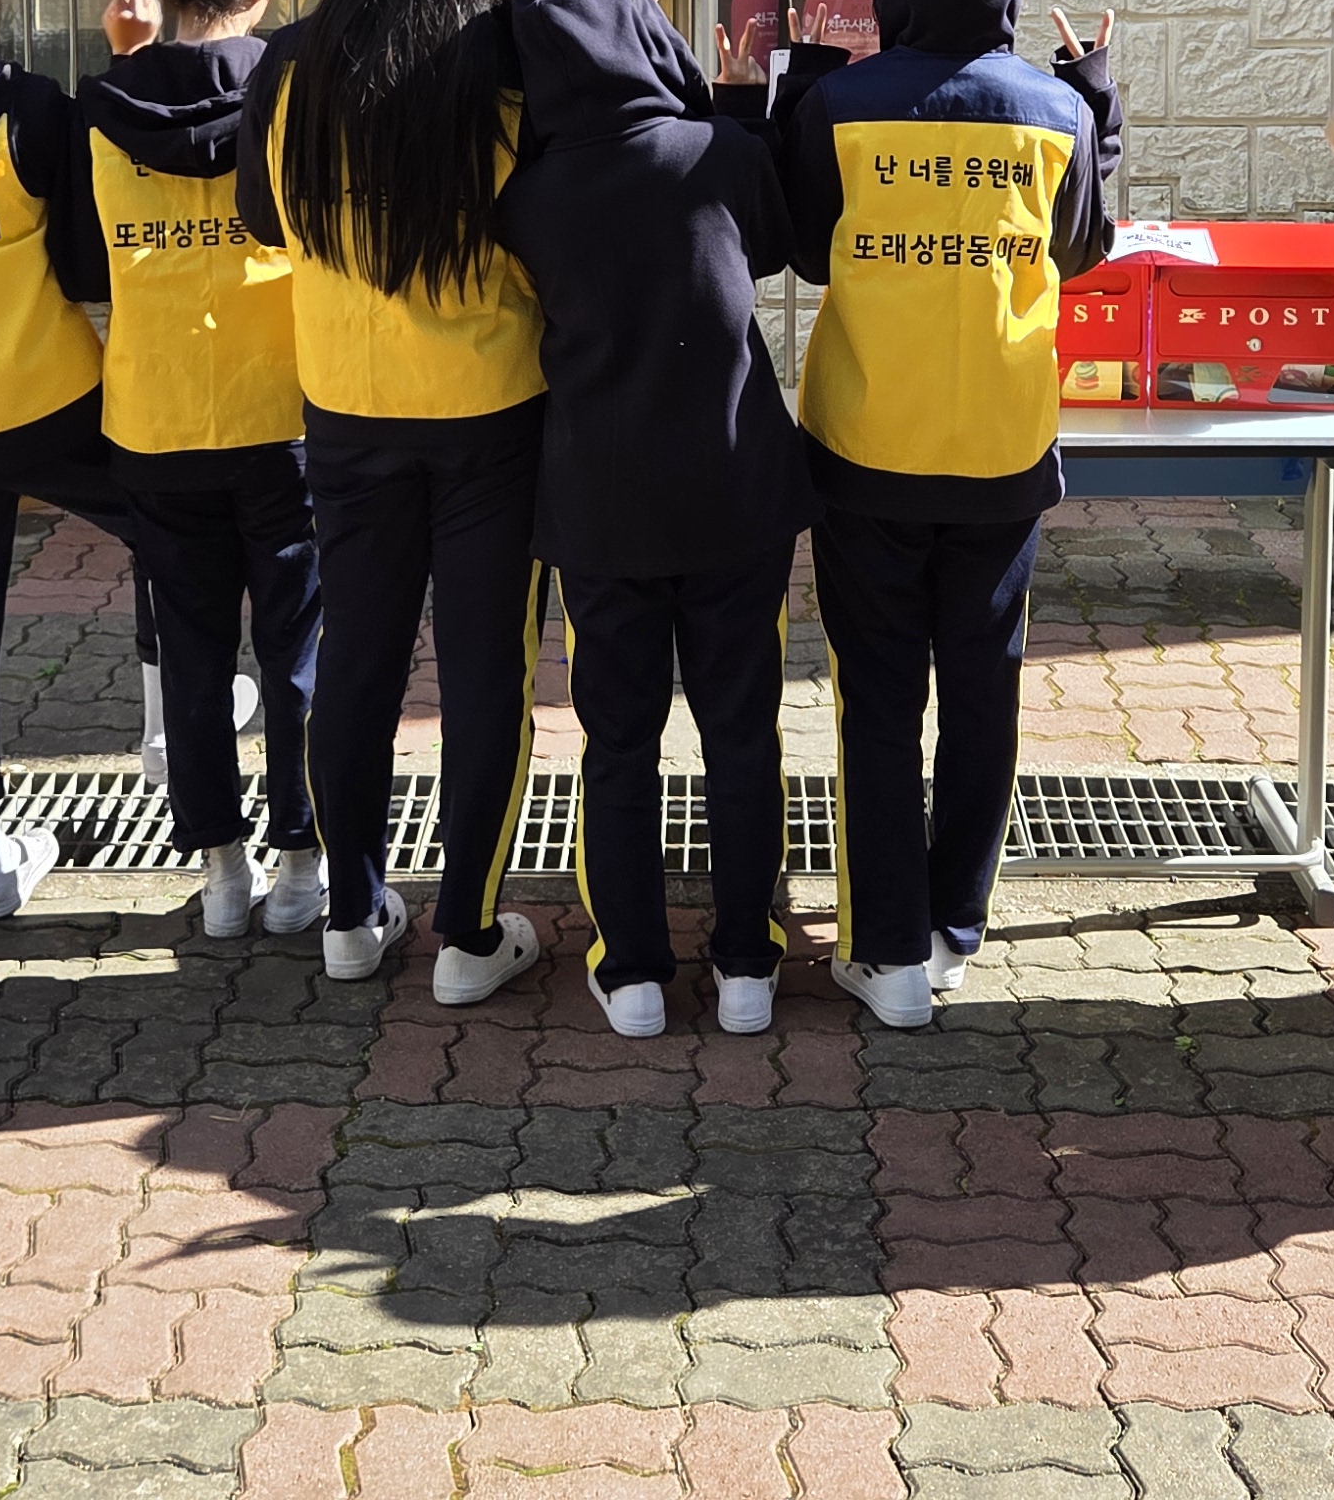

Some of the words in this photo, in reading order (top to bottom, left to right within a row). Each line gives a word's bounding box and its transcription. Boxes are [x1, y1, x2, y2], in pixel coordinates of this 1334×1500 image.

[874, 155, 898, 185] 난
[909, 156, 953, 187] 너를
[964, 157, 1034, 189] 응원해
[853, 233, 1043, 267] 또래상담동아리
[1219, 307, 1330, 326] POST
